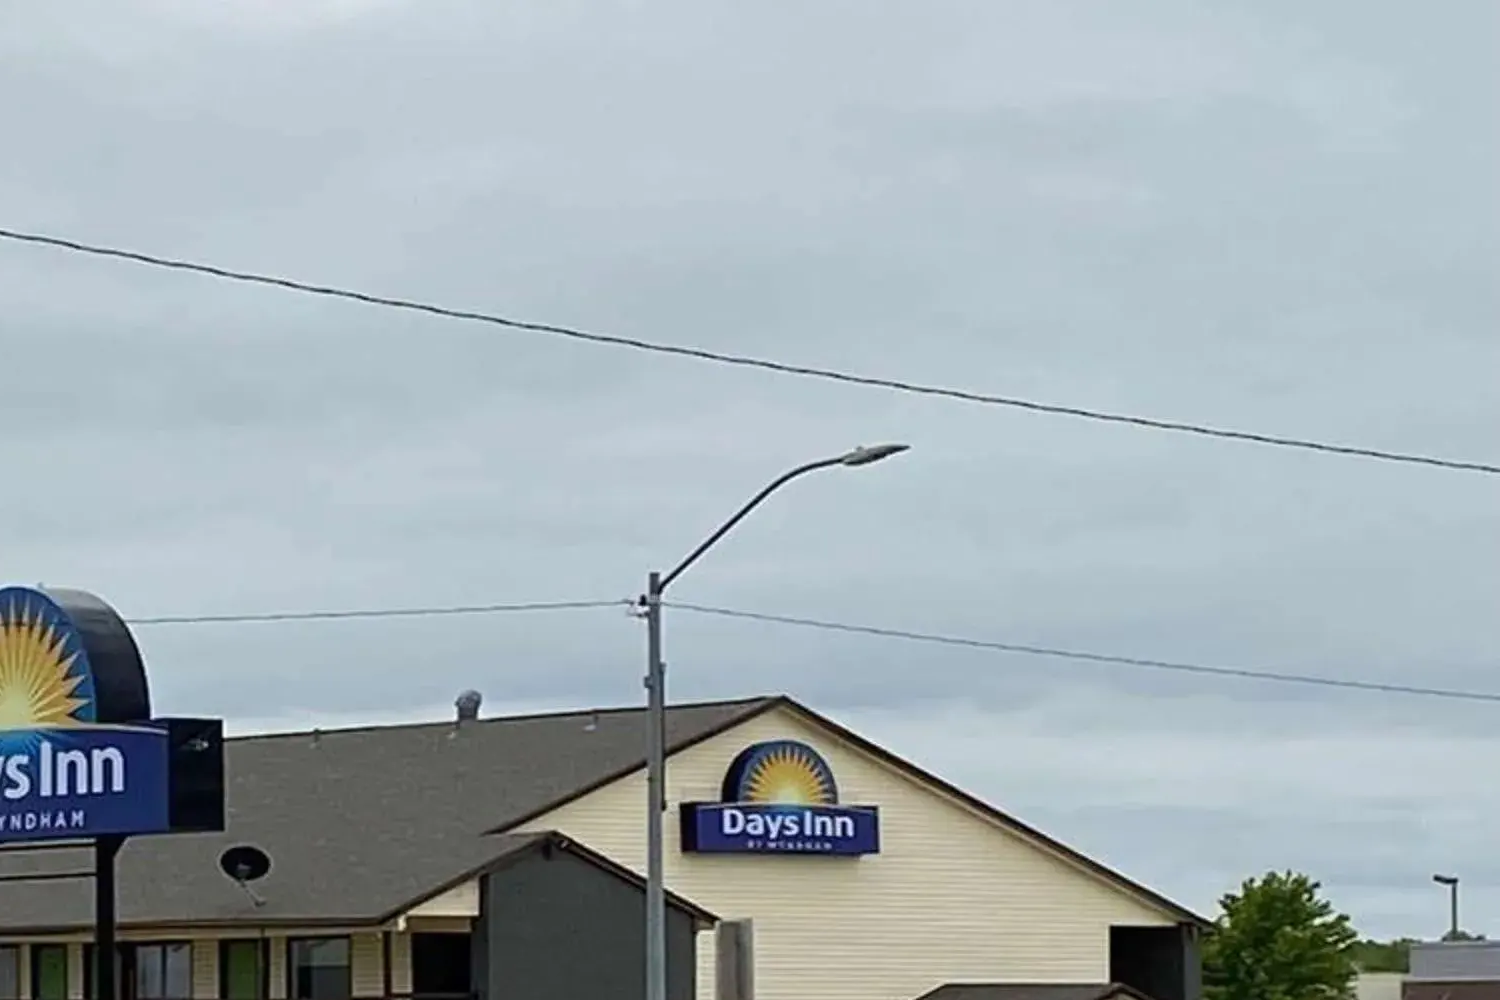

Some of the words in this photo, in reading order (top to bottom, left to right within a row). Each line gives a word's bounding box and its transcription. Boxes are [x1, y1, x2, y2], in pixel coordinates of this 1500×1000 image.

[40, 741, 124, 797] Inn
[723, 809, 799, 838] Days
[804, 811, 854, 837] Inn
